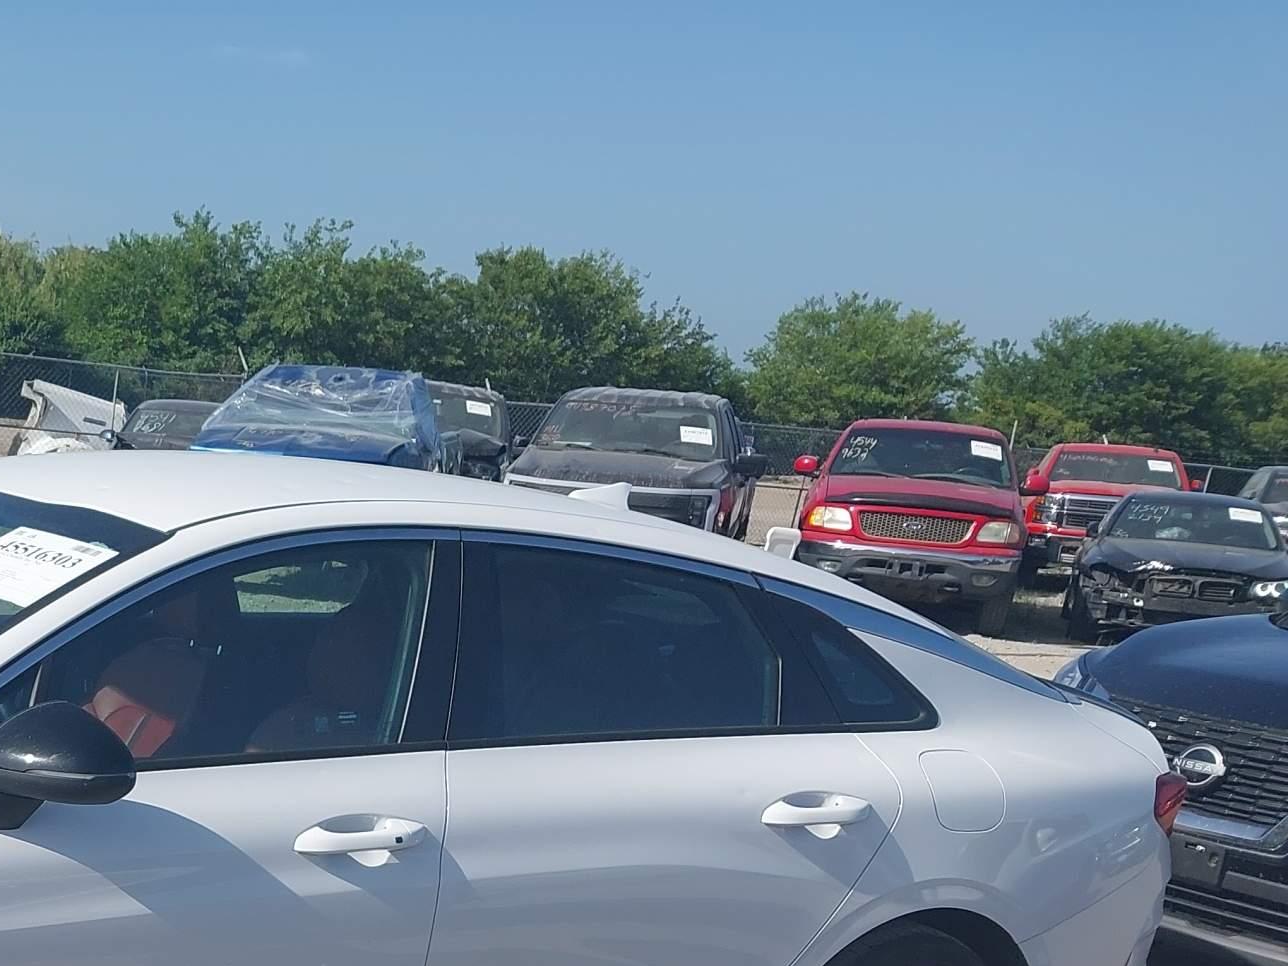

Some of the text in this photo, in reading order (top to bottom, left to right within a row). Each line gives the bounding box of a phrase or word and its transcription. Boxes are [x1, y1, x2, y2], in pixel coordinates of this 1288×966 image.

[850, 436, 878, 450] 4544
[0, 541, 83, 568] 45516303
[1173, 757, 1220, 775] NISSA
